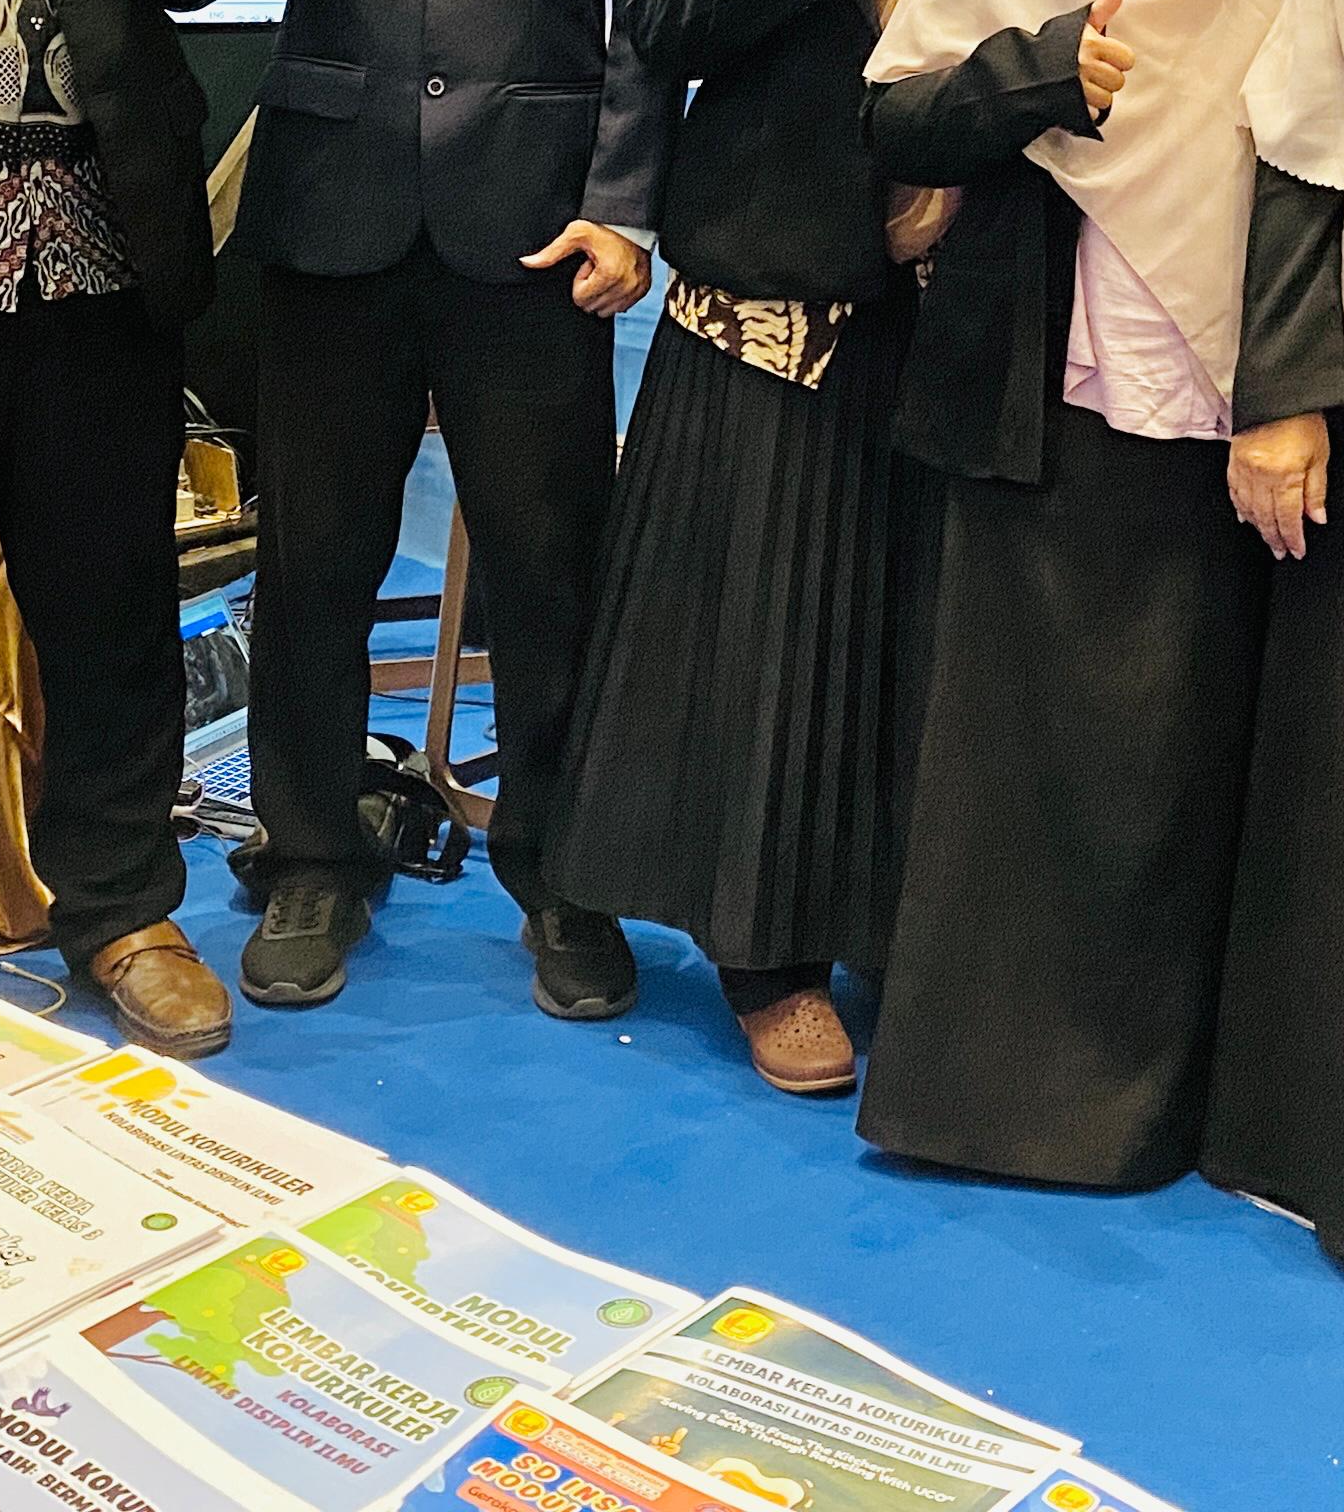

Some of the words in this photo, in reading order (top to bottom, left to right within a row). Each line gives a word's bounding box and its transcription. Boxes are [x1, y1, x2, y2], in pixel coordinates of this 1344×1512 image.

[104, 1112, 173, 1155] KOLABORASI
[167, 1148, 209, 1172] LINTAS
[204, 1166, 253, 1199] DISIPLIN
[123, 1098, 190, 1139] MODUL
[183, 1132, 315, 1198] KOKURIKULER
[32, 1199, 92, 1235] KELAS
[37, 1180, 95, 1216] KERJA
[455, 1294, 574, 1356] MODUL
[246, 1329, 437, 1442] KOKURIKULER
[262, 1308, 377, 1382] LEMBAR
[372, 1374, 461, 1426] KERJA
[703, 1348, 785, 1386] LEMBAR
[784, 1375, 855, 1410] KERJA
[857, 1401, 1006, 1457] KOKURIKULER
[172, 1354, 241, 1401] LINTAS
[233, 1396, 323, 1449] DISIPLIN
[314, 1442, 372, 1476] ILMU
[276, 1389, 400, 1460] KOLABORASI
[685, 1373, 792, 1416] KOLABORASI
[791, 1406, 853, 1437] LINTAS
[854, 1430, 929, 1463] DISIPLIN
[926, 1455, 973, 1475] ILMU
[706, 1413, 749, 1437] Earth
[877, 1469, 912, 1493] With
[36, 1473, 102, 1512] BERM
[515, 1454, 557, 1481] SD
